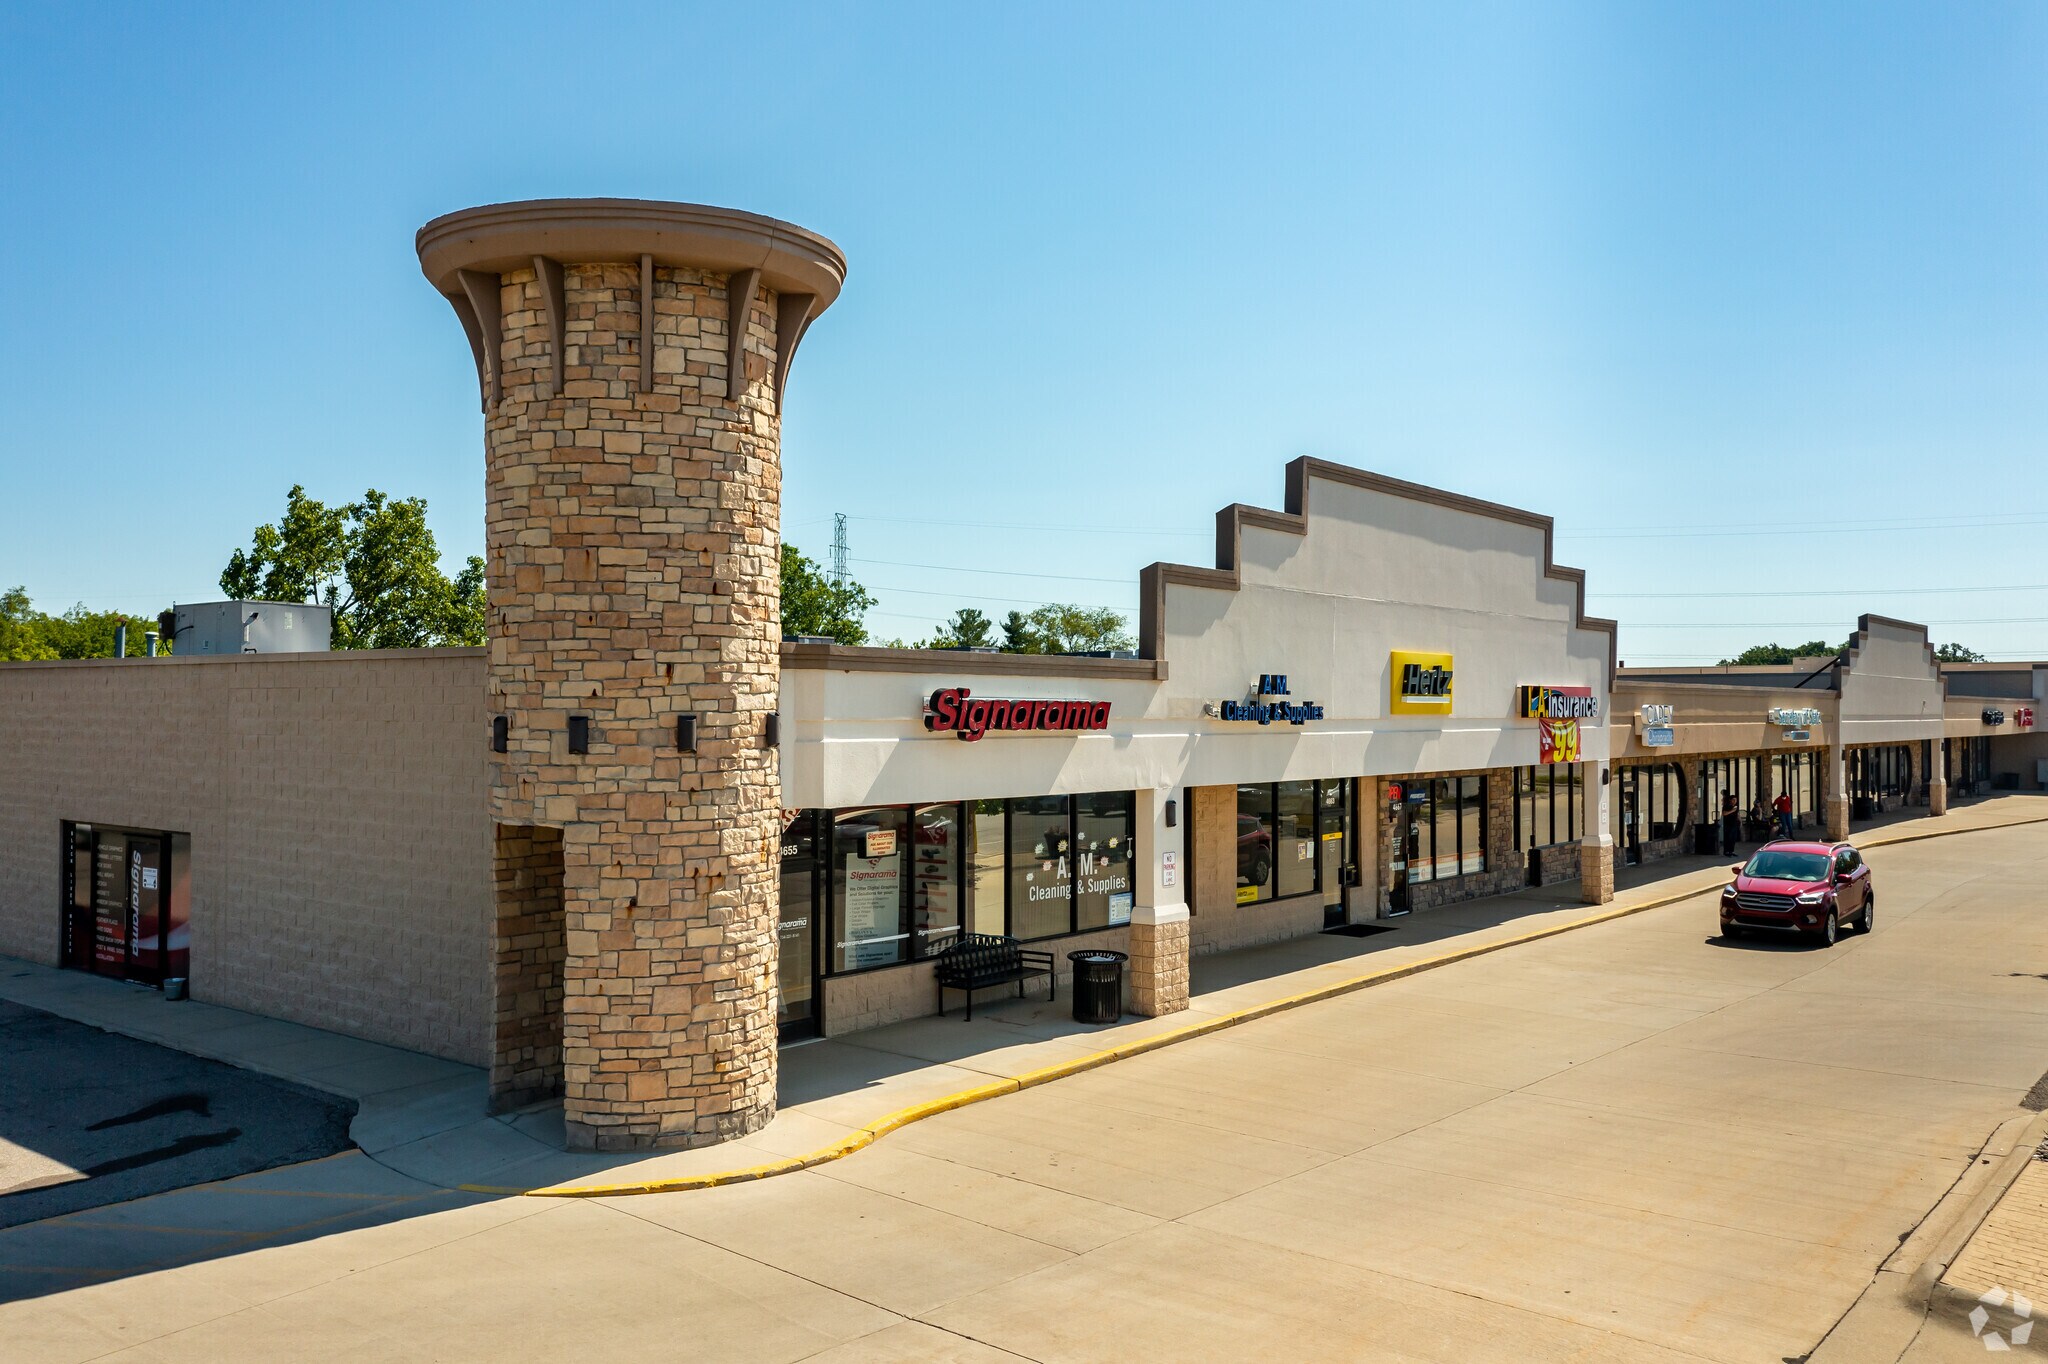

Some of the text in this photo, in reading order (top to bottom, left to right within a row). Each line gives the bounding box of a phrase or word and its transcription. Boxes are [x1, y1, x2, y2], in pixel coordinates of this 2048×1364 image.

[1260, 673, 1291, 695] A.M.
[1402, 663, 1453, 696] Hertz
[924, 687, 1112, 742] Signarama
[1221, 700, 1271, 725] Cleaning
[1280, 700, 1324, 725] Supplies
[1549, 694, 1598, 718] insurance
[868, 832, 895, 842] Signarama
[850, 870, 897, 882] Signarama
[1029, 874, 1126, 901] Cleaning & Supplies
[131, 850, 142, 957] Signarama
